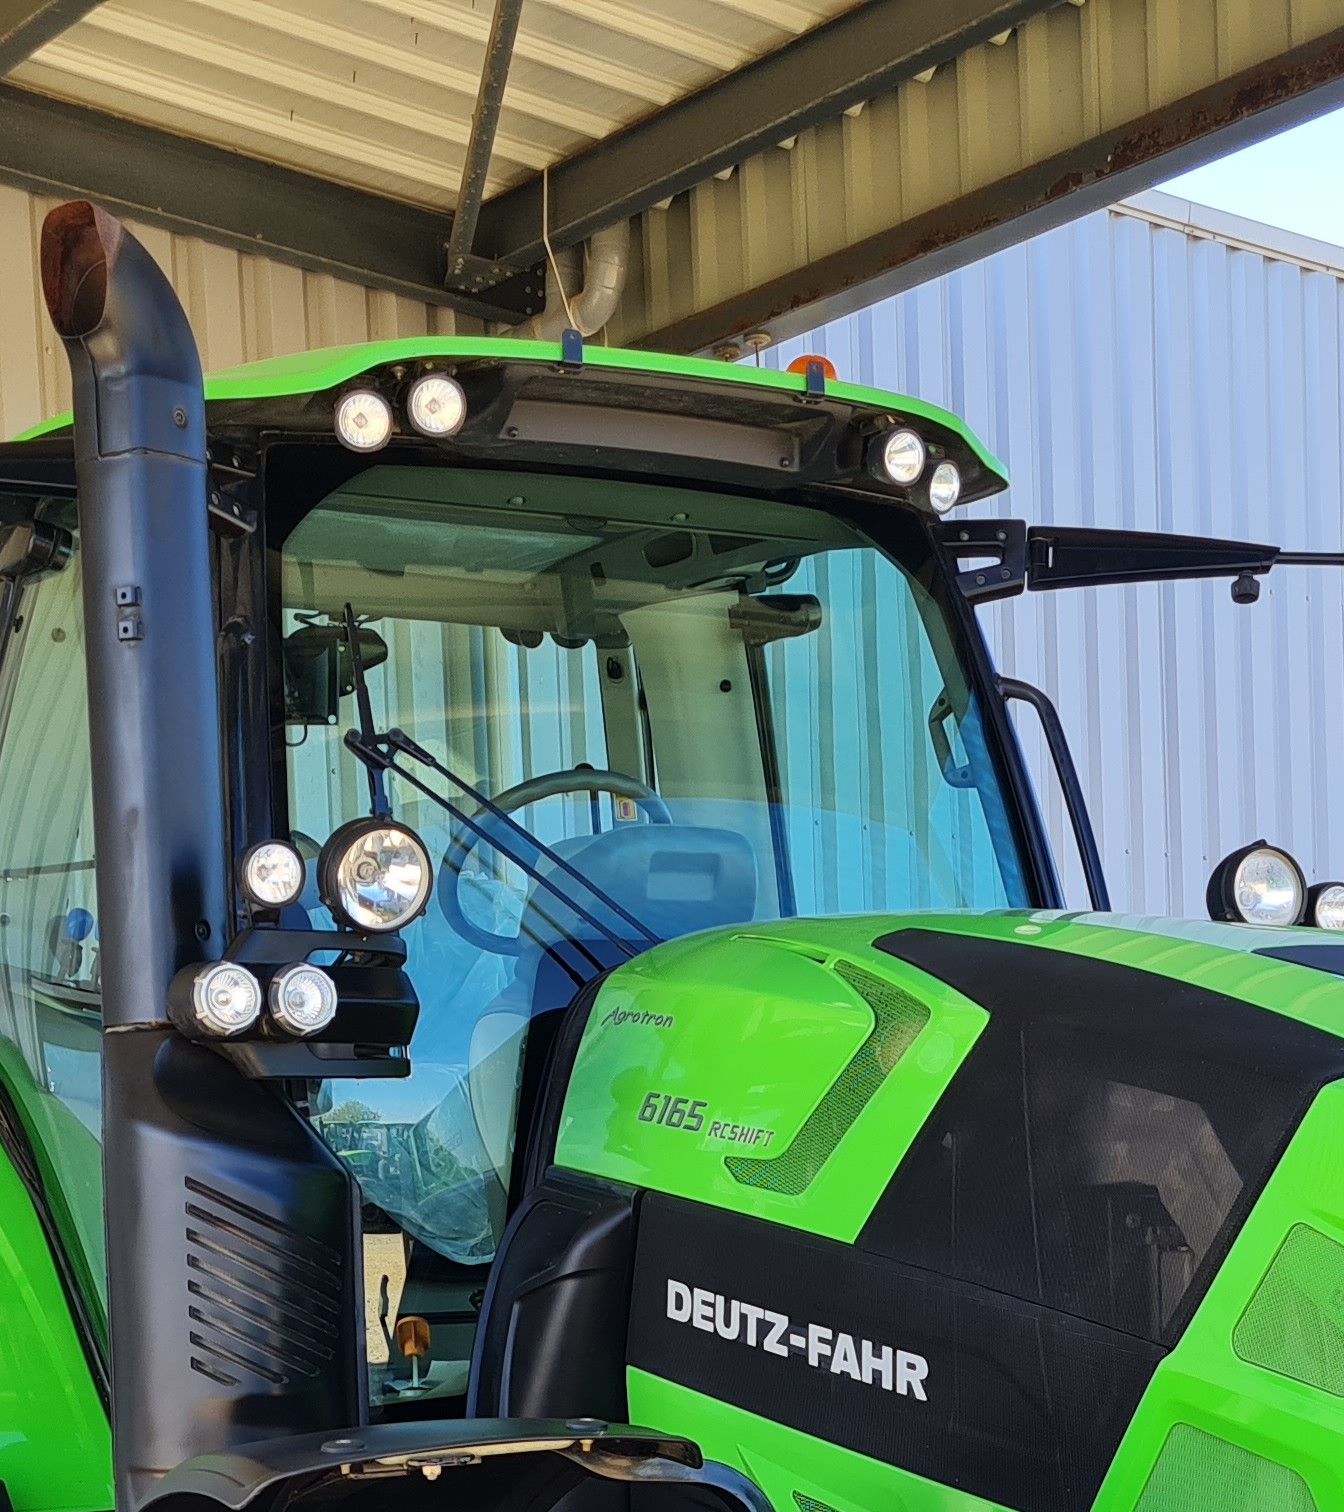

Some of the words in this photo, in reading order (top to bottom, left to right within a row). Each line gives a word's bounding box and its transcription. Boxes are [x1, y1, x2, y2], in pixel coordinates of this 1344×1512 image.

[601, 1006, 674, 1027] Agrotron
[638, 1092, 707, 1131] 6165
[707, 1121, 775, 1147] RCSHIFT
[667, 1279, 929, 1401] DEUTZ-FAHR
